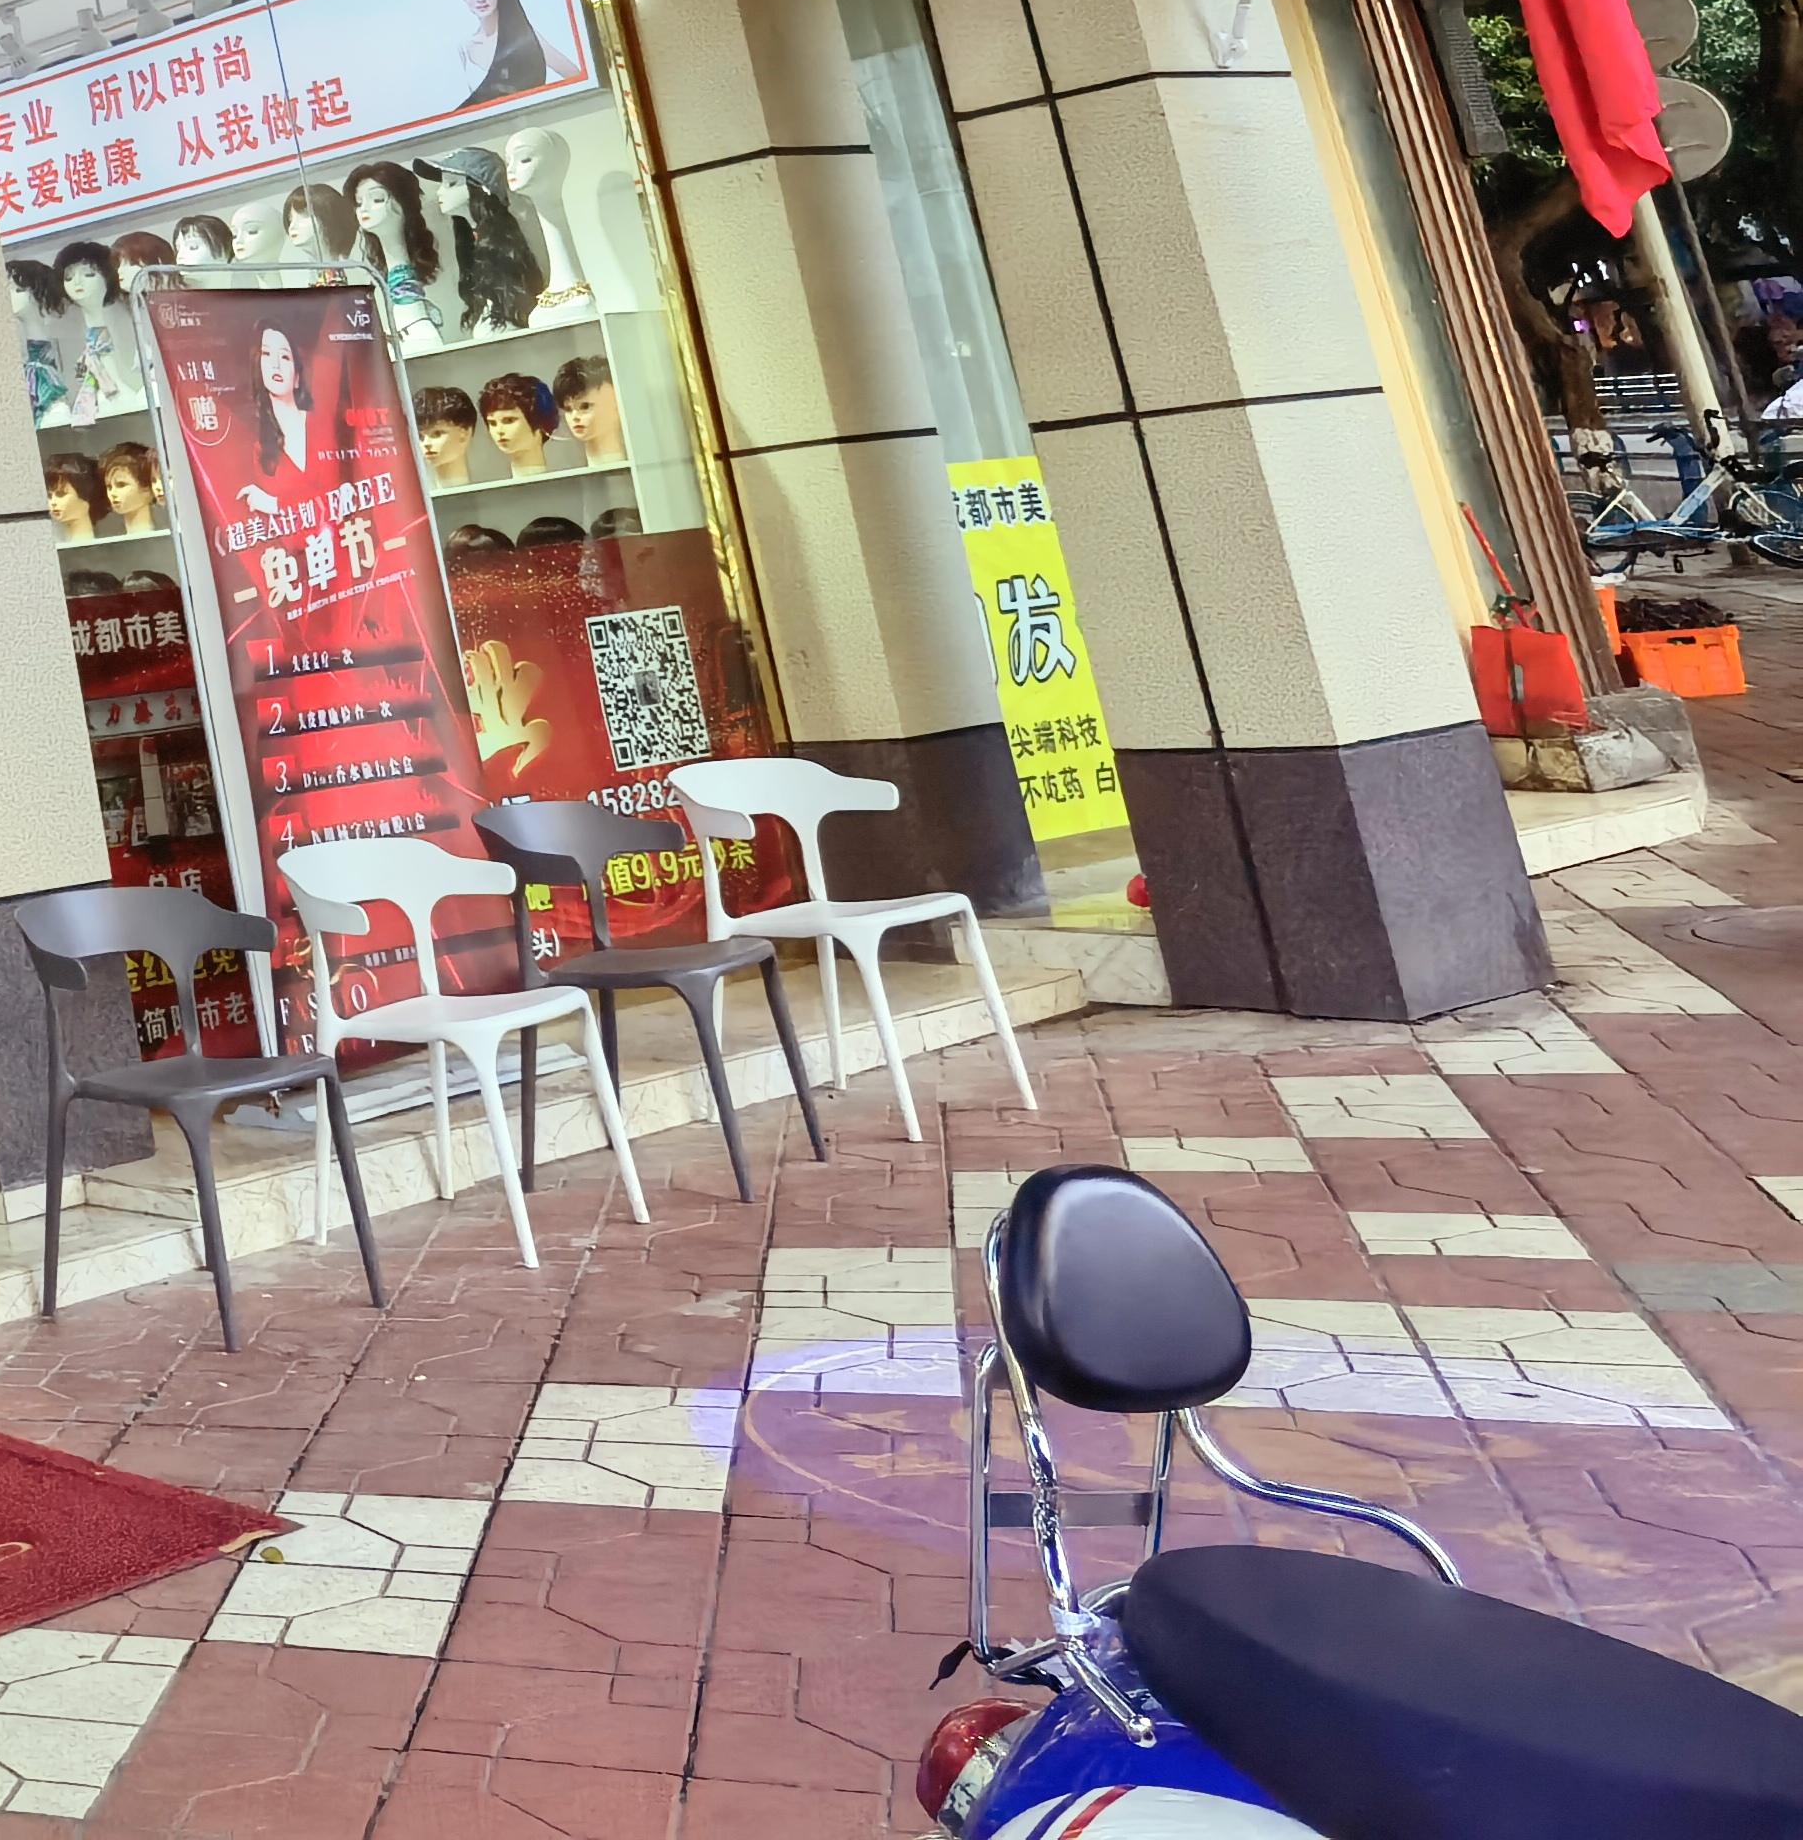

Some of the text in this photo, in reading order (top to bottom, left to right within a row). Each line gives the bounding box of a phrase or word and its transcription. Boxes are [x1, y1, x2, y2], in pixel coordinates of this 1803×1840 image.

[87, 35, 252, 125] 所以时尚
[176, 76, 352, 166] 从我做起
